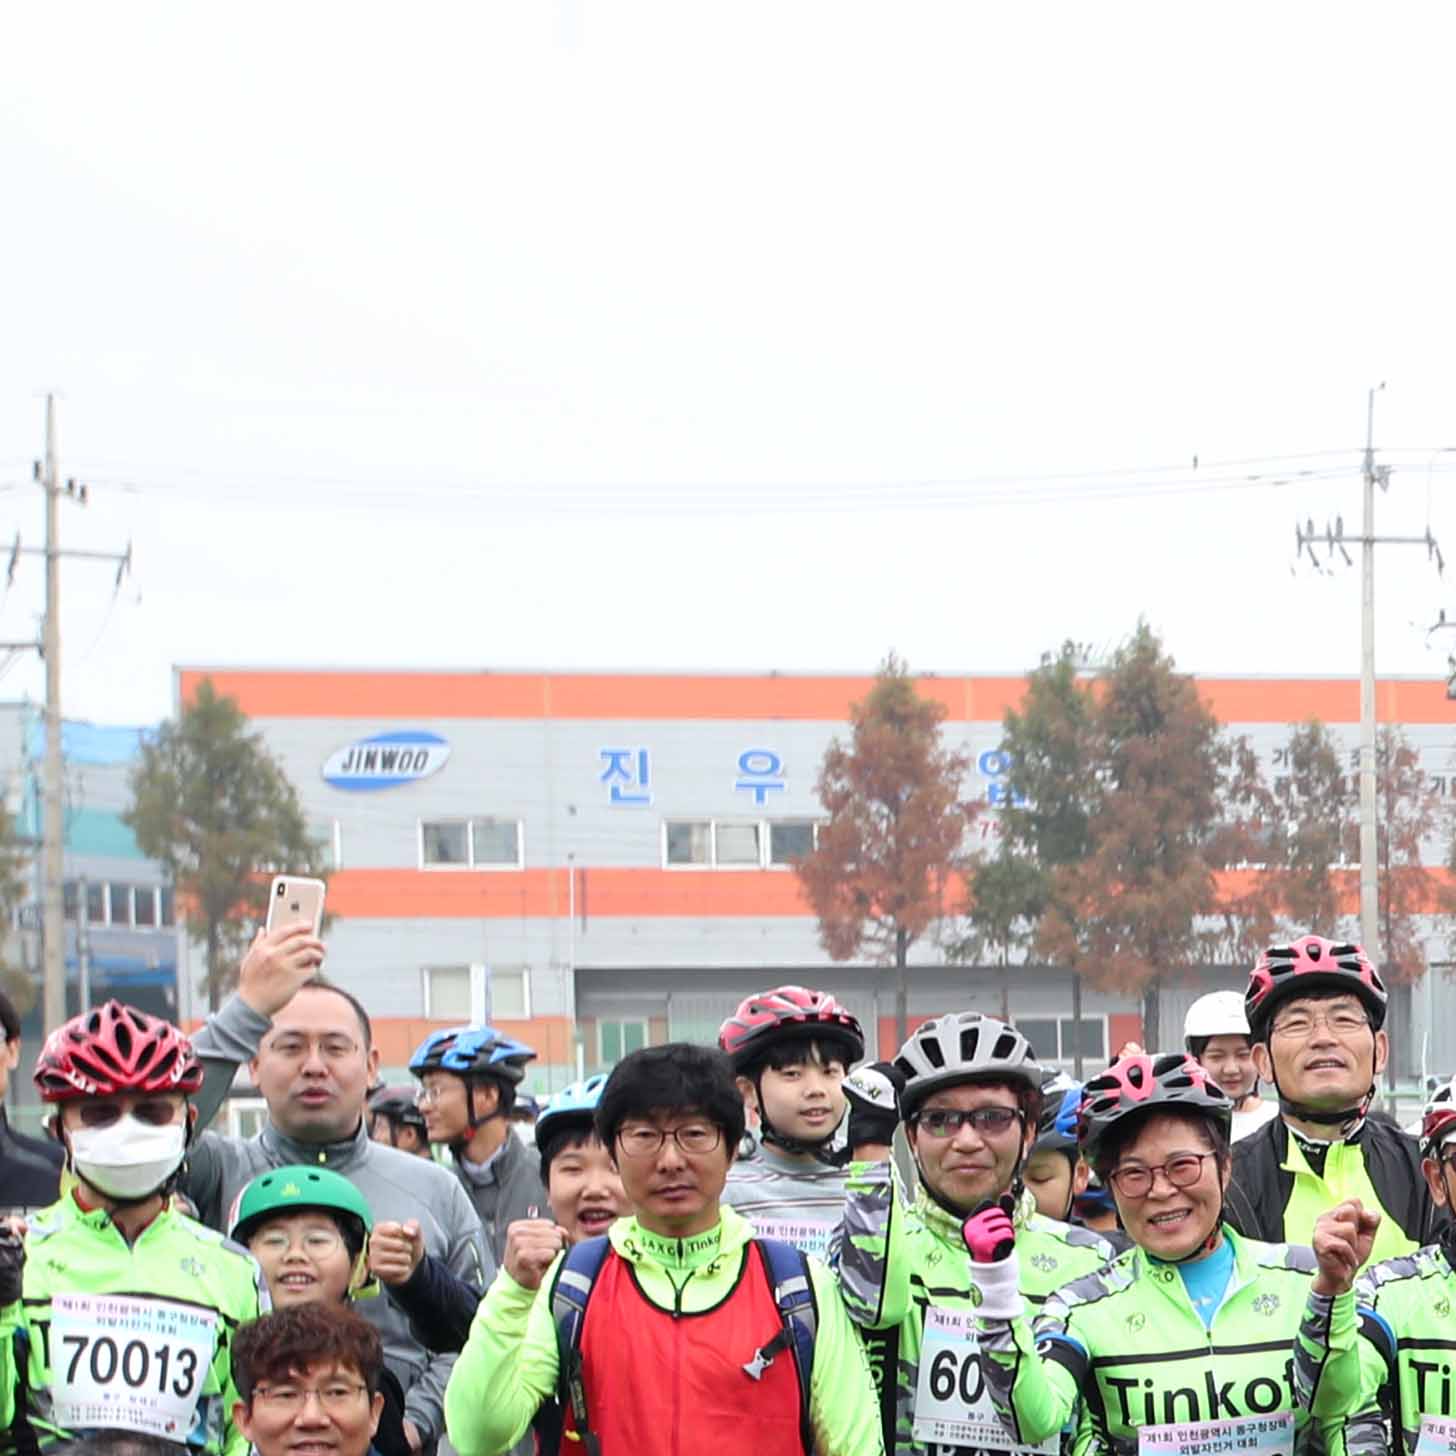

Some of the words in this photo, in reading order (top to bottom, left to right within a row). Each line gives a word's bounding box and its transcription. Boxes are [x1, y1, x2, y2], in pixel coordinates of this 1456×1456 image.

[341, 747, 431, 774] JINWOO
[63, 1335, 198, 1398] 70013
[1177, 1427, 1232, 1443] 인천광역시
[1237, 1437, 1258, 1450] 대회
